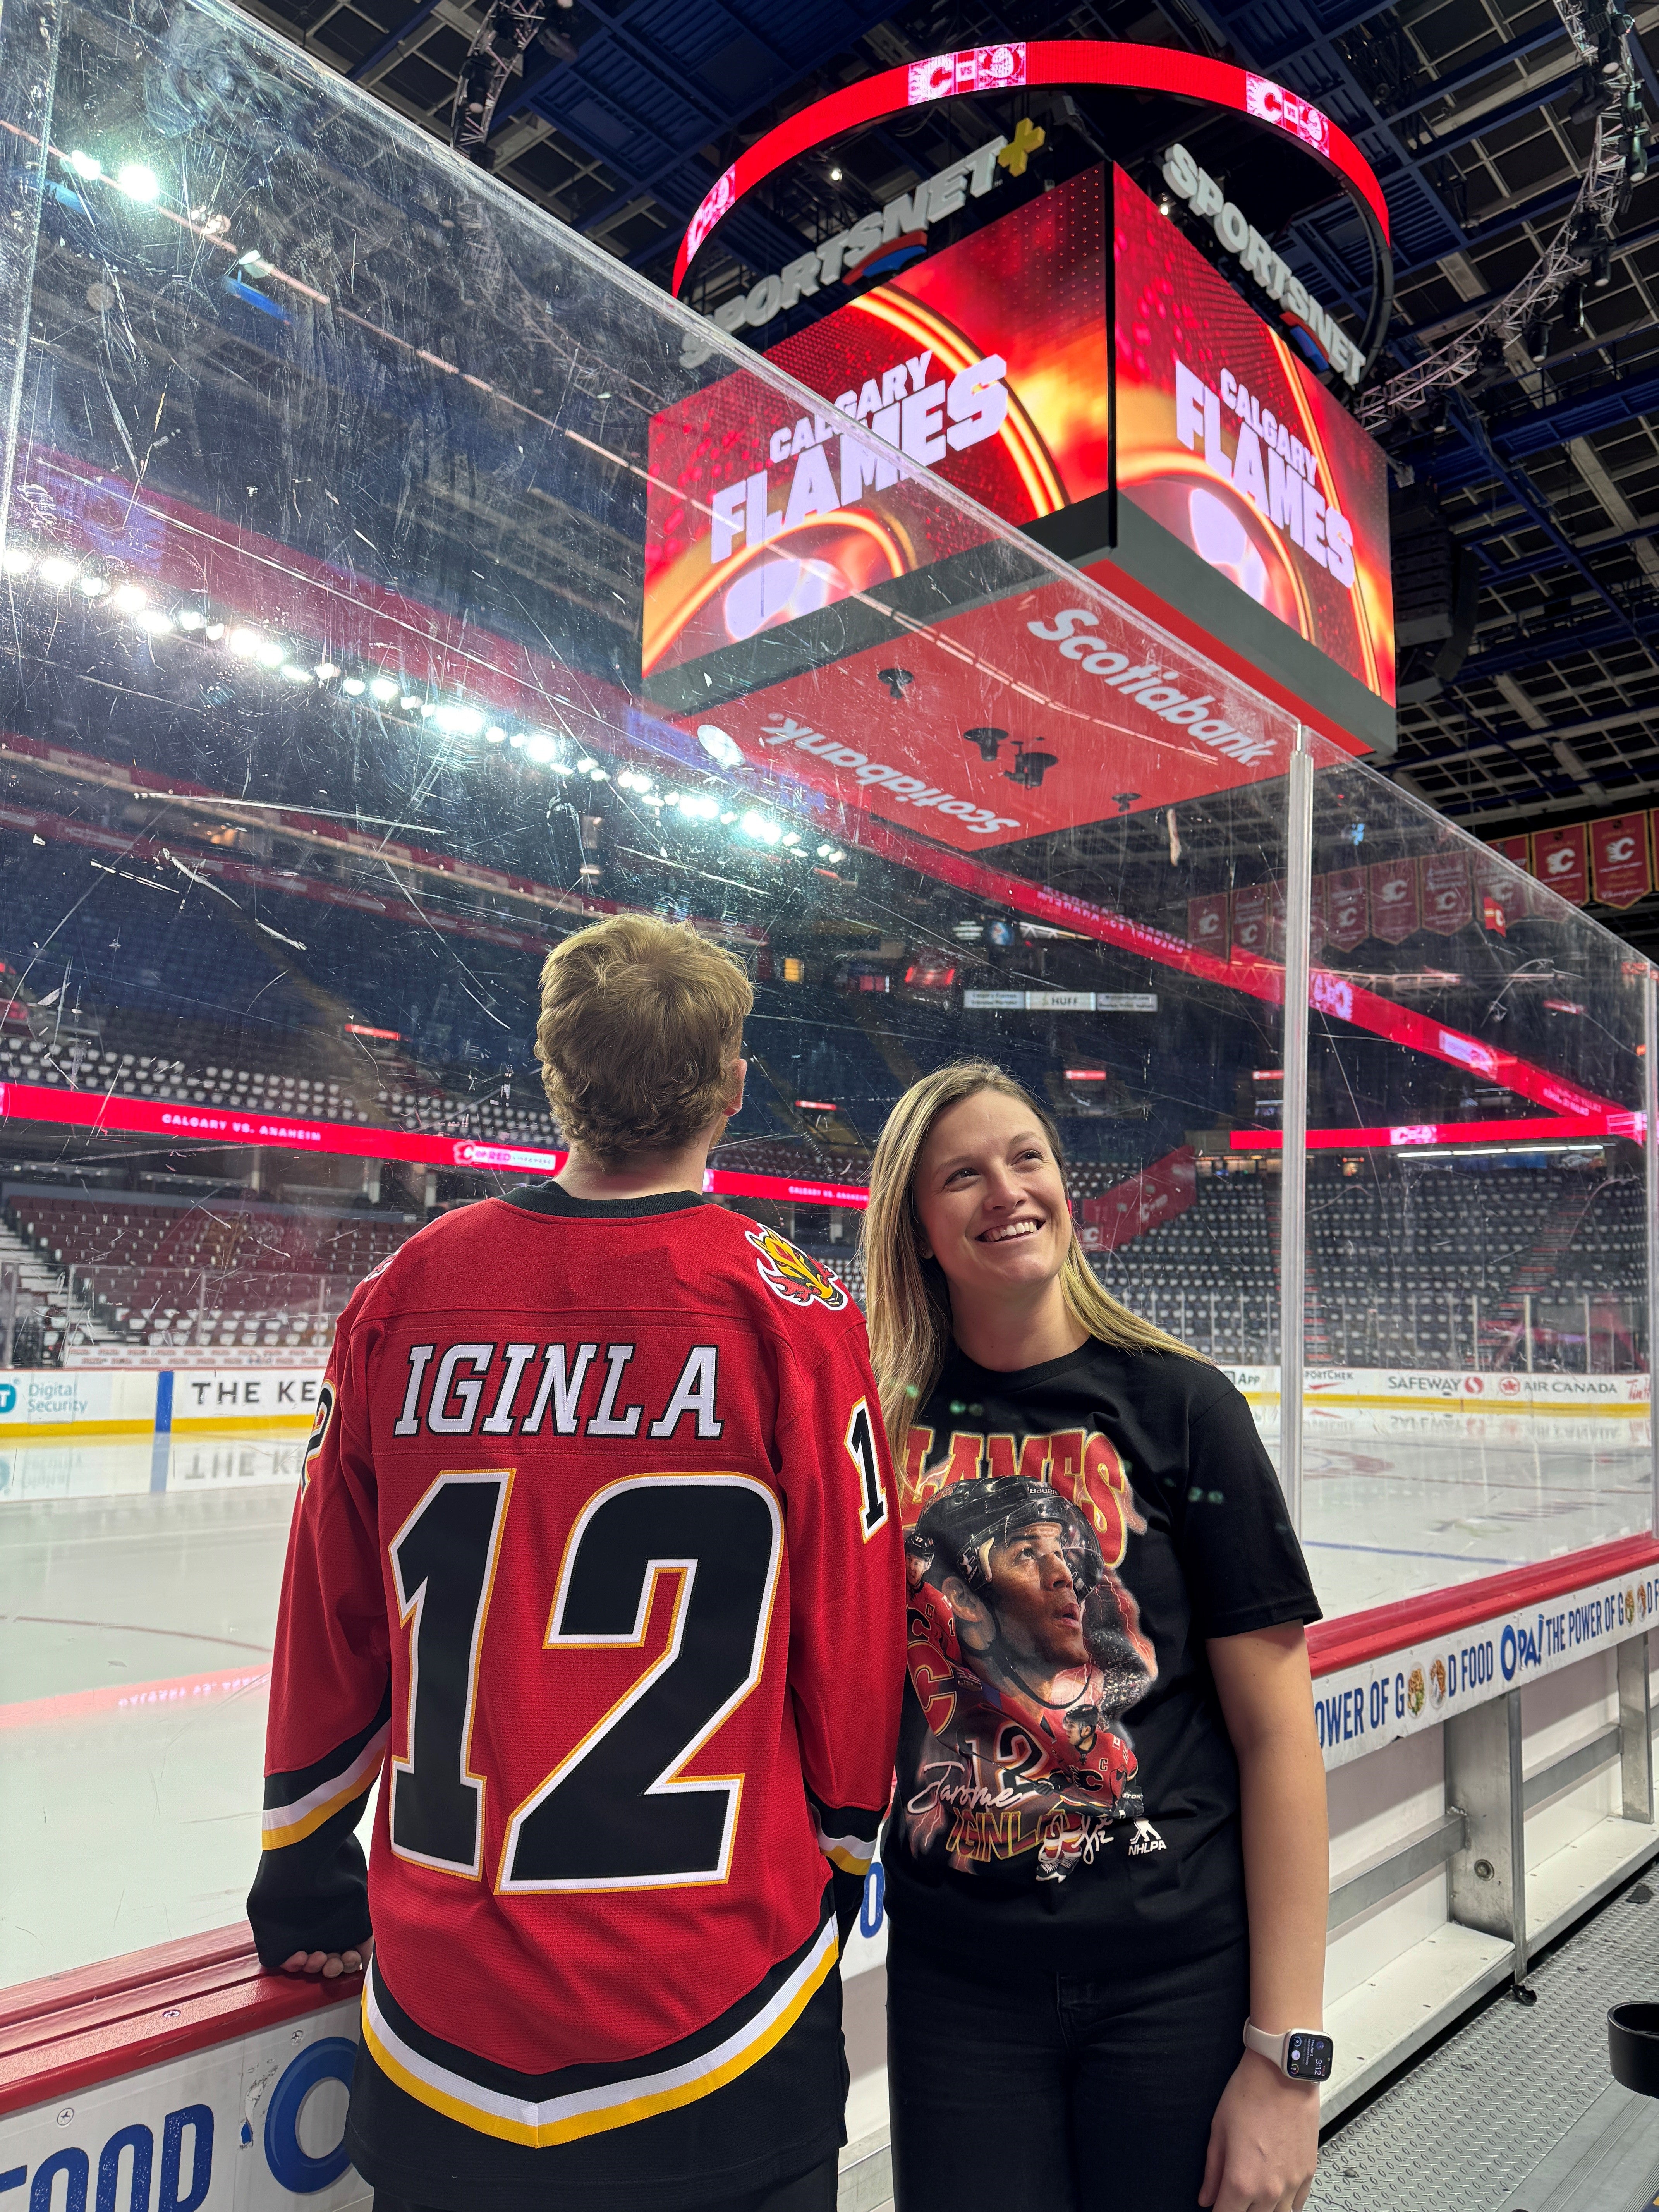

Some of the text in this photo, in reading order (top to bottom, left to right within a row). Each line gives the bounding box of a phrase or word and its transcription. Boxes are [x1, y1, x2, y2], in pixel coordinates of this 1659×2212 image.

[960, 65, 972, 76] VS
[1162, 143, 1367, 385] SPORTSNET
[769, 350, 934, 463] CALGARY
[1220, 368, 1317, 486] CALGARY
[711, 354, 1008, 564] FLAMES
[1176, 360, 1355, 588] FLAMES
[1027, 609, 1277, 765] Scotiabank
[760, 716, 1021, 834] Scotiabank
[1051, 996, 1079, 1005] HUFF
[161, 1113, 321, 1141] CALGARY VS. ANAHEIM
[28, 1382, 76, 1400] Digital
[28, 1398, 88, 1414] Security
[191, 1381, 261, 1405] THE
[392, 1342, 725, 1440] IGINLA
[1304, 1370, 1354, 1381] PORTCHEK
[1388, 1376, 1463, 1391] SAFEWAY
[1524, 1381, 1618, 1394] AIR CANADA
[1501, 1613, 1544, 1682] OPA!
[1546, 1610, 1566, 1657] THE
[1569, 1599, 1602, 1646] POWER
[1604, 1595, 1616, 1637] OF
[387, 1468, 785, 1896] 12
[1314, 1684, 1365, 1752] OWER
[1370, 1677, 1390, 1730] OF
[1462, 1640, 1494, 1692] FOOD
[1128, 1839, 1167, 1856] NHLPA
[1314, 2059, 1322, 2075] 3:12
[0, 2104, 214, 2212] OOD
